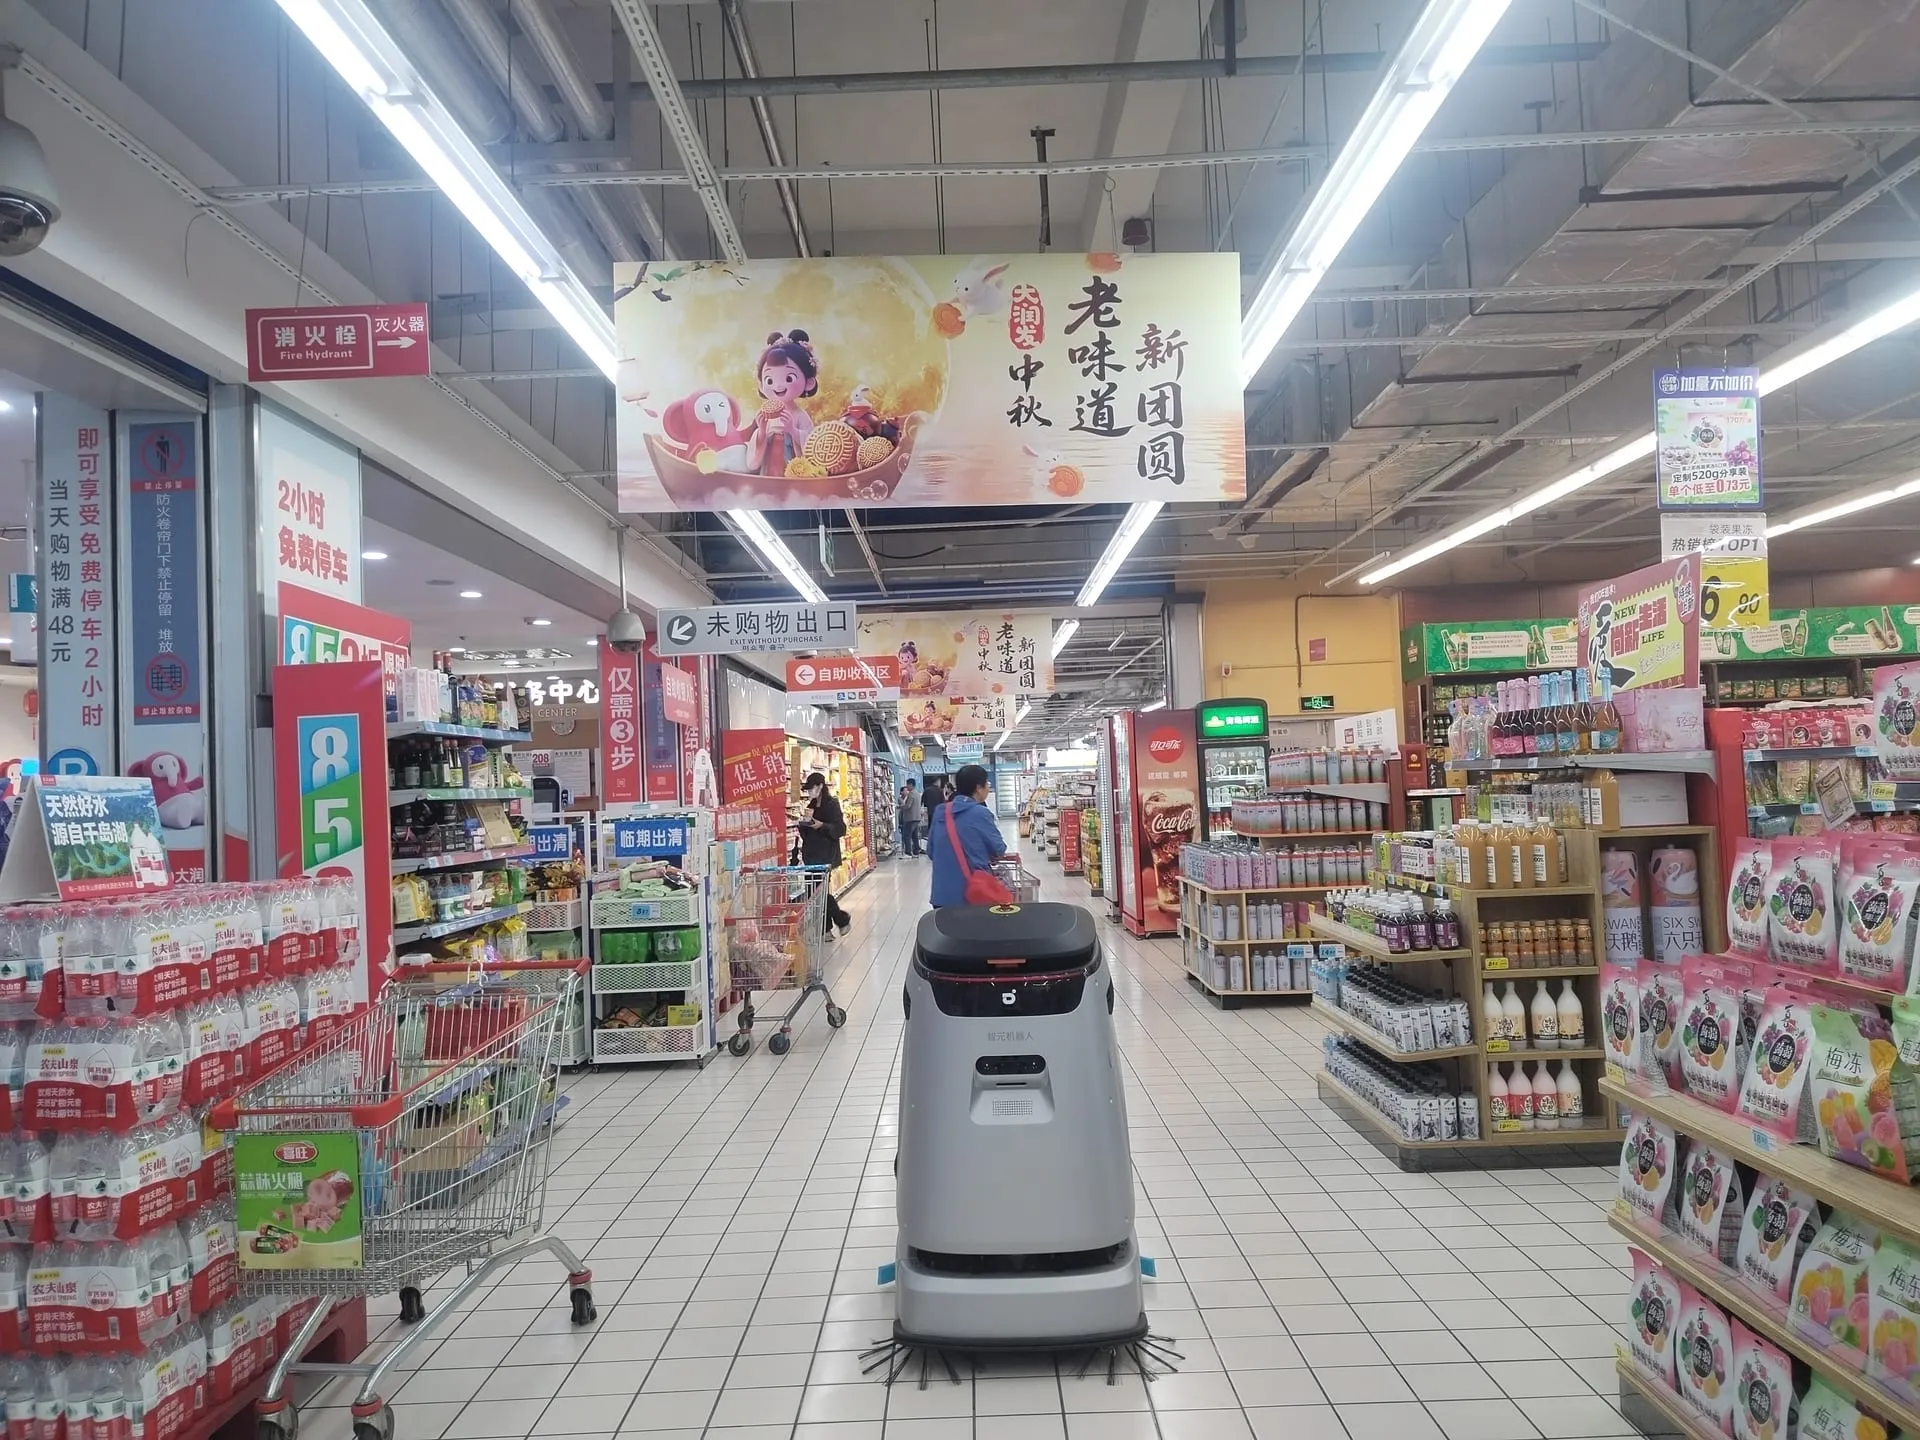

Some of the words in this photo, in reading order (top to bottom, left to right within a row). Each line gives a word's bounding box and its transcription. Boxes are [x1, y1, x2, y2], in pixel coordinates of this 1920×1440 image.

[375, 316, 425, 333] 灭火器
[1011, 285, 1043, 348] 大润发
[274, 325, 357, 348] 消火栓
[280, 351, 303, 360] Fire
[306, 350, 353, 361] Hydrant
[1065, 275, 1132, 438] 老味道
[1007, 353, 1053, 429] 中秋
[1680, 375, 1754, 392] 加量不加价
[1135, 322, 1190, 486] 新团圆
[1673, 467, 1748, 484] 定制520g分享装
[278, 479, 326, 530] 2小时
[1709, 524, 1754, 536] 袋装果冻
[278, 525, 349, 585] 免费停车
[48, 479, 74, 663] 当天购物满48元
[77, 428, 104, 727] 即可享受免费停车2小时
[1702, 576, 1721, 622] 6
[707, 609, 847, 637] 未购物出口
[1614, 604, 1637, 621] NEW
[748, 637, 782, 645] WITHOUT
[783, 635, 823, 643] PURCHASE
[1641, 630, 1665, 644] LIFE
[996, 622, 1018, 674] 老味道
[978, 648, 993, 672] 中秋
[1018, 637, 1036, 689] 新团圆
[819, 665, 891, 682] 自助收银区
[538, 708, 577, 718] CENTER
[1150, 739, 1182, 751] 可口可乐
[532, 753, 550, 764] 208
[733, 751, 786, 785] 促销
[45, 794, 109, 818] 天然好水
[51, 821, 129, 846] 源自千岛湖
[620, 829, 683, 850] 临期出清
[1663, 917, 1684, 929] SIX
[1604, 931, 1638, 951] 天鹅
[987, 1031, 1034, 1042] 智元机器人
[41, 1058, 78, 1070] 农夫山泉
[1825, 1047, 1863, 1074] 梅冻
[283, 1146, 308, 1159] 喜旺
[239, 1171, 304, 1190] 蒜味火腿
[1829, 1227, 1868, 1257] 梅冻
[32, 1282, 77, 1294] 农夫山泉
